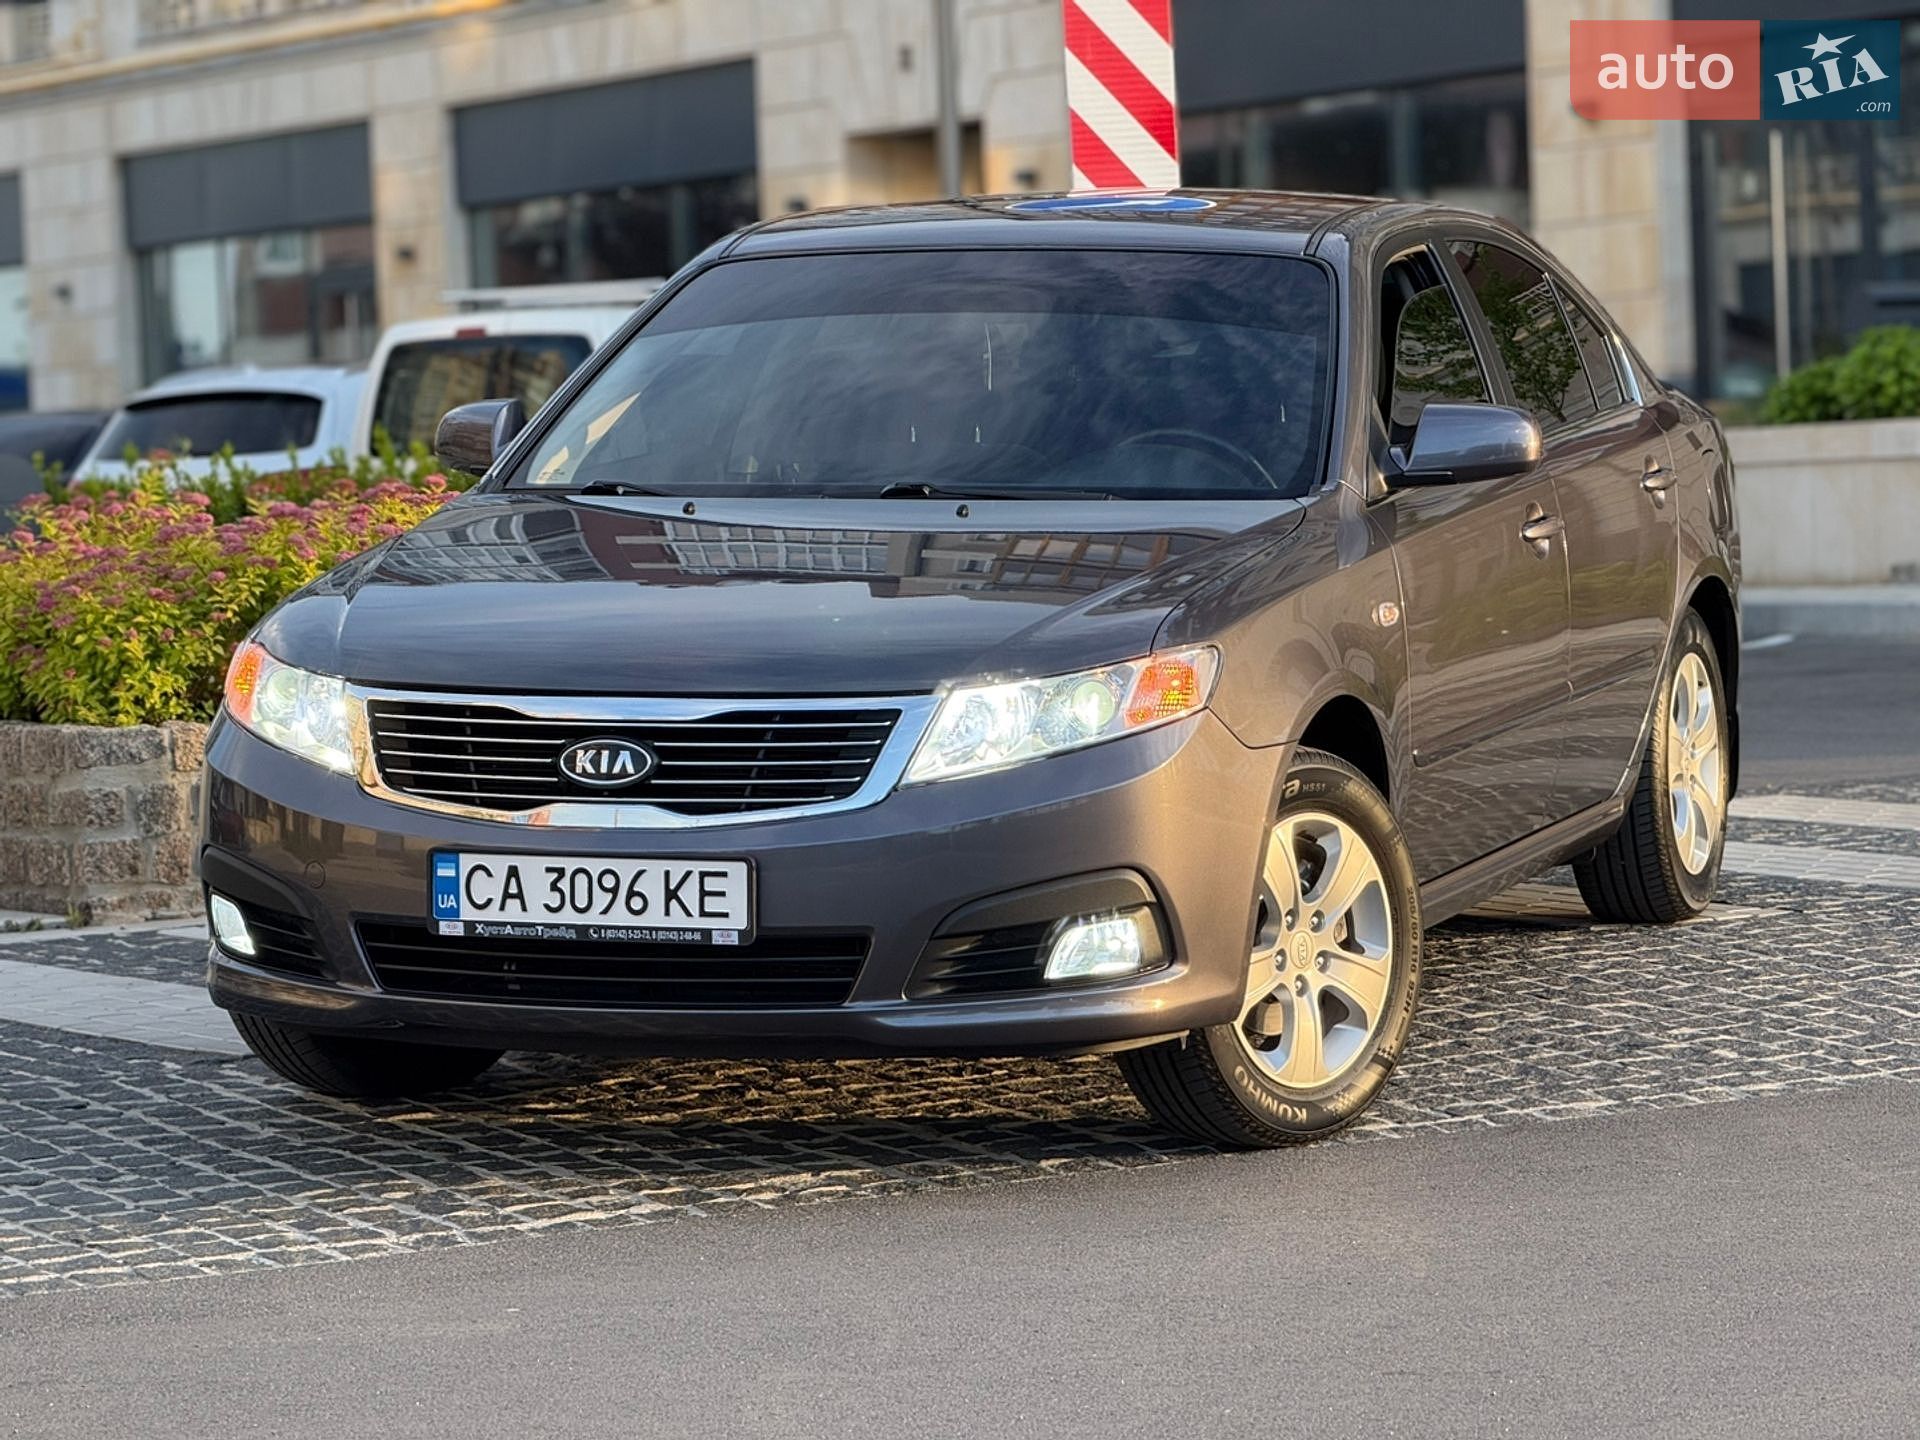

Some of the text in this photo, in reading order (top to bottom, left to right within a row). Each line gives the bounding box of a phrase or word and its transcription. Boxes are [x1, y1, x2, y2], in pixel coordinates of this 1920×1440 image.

[575, 749, 635, 774] KIA
[438, 893, 457, 909] UA
[465, 863, 729, 918] CA 3096 KE
[1234, 1065, 1307, 1124] KUMHO
